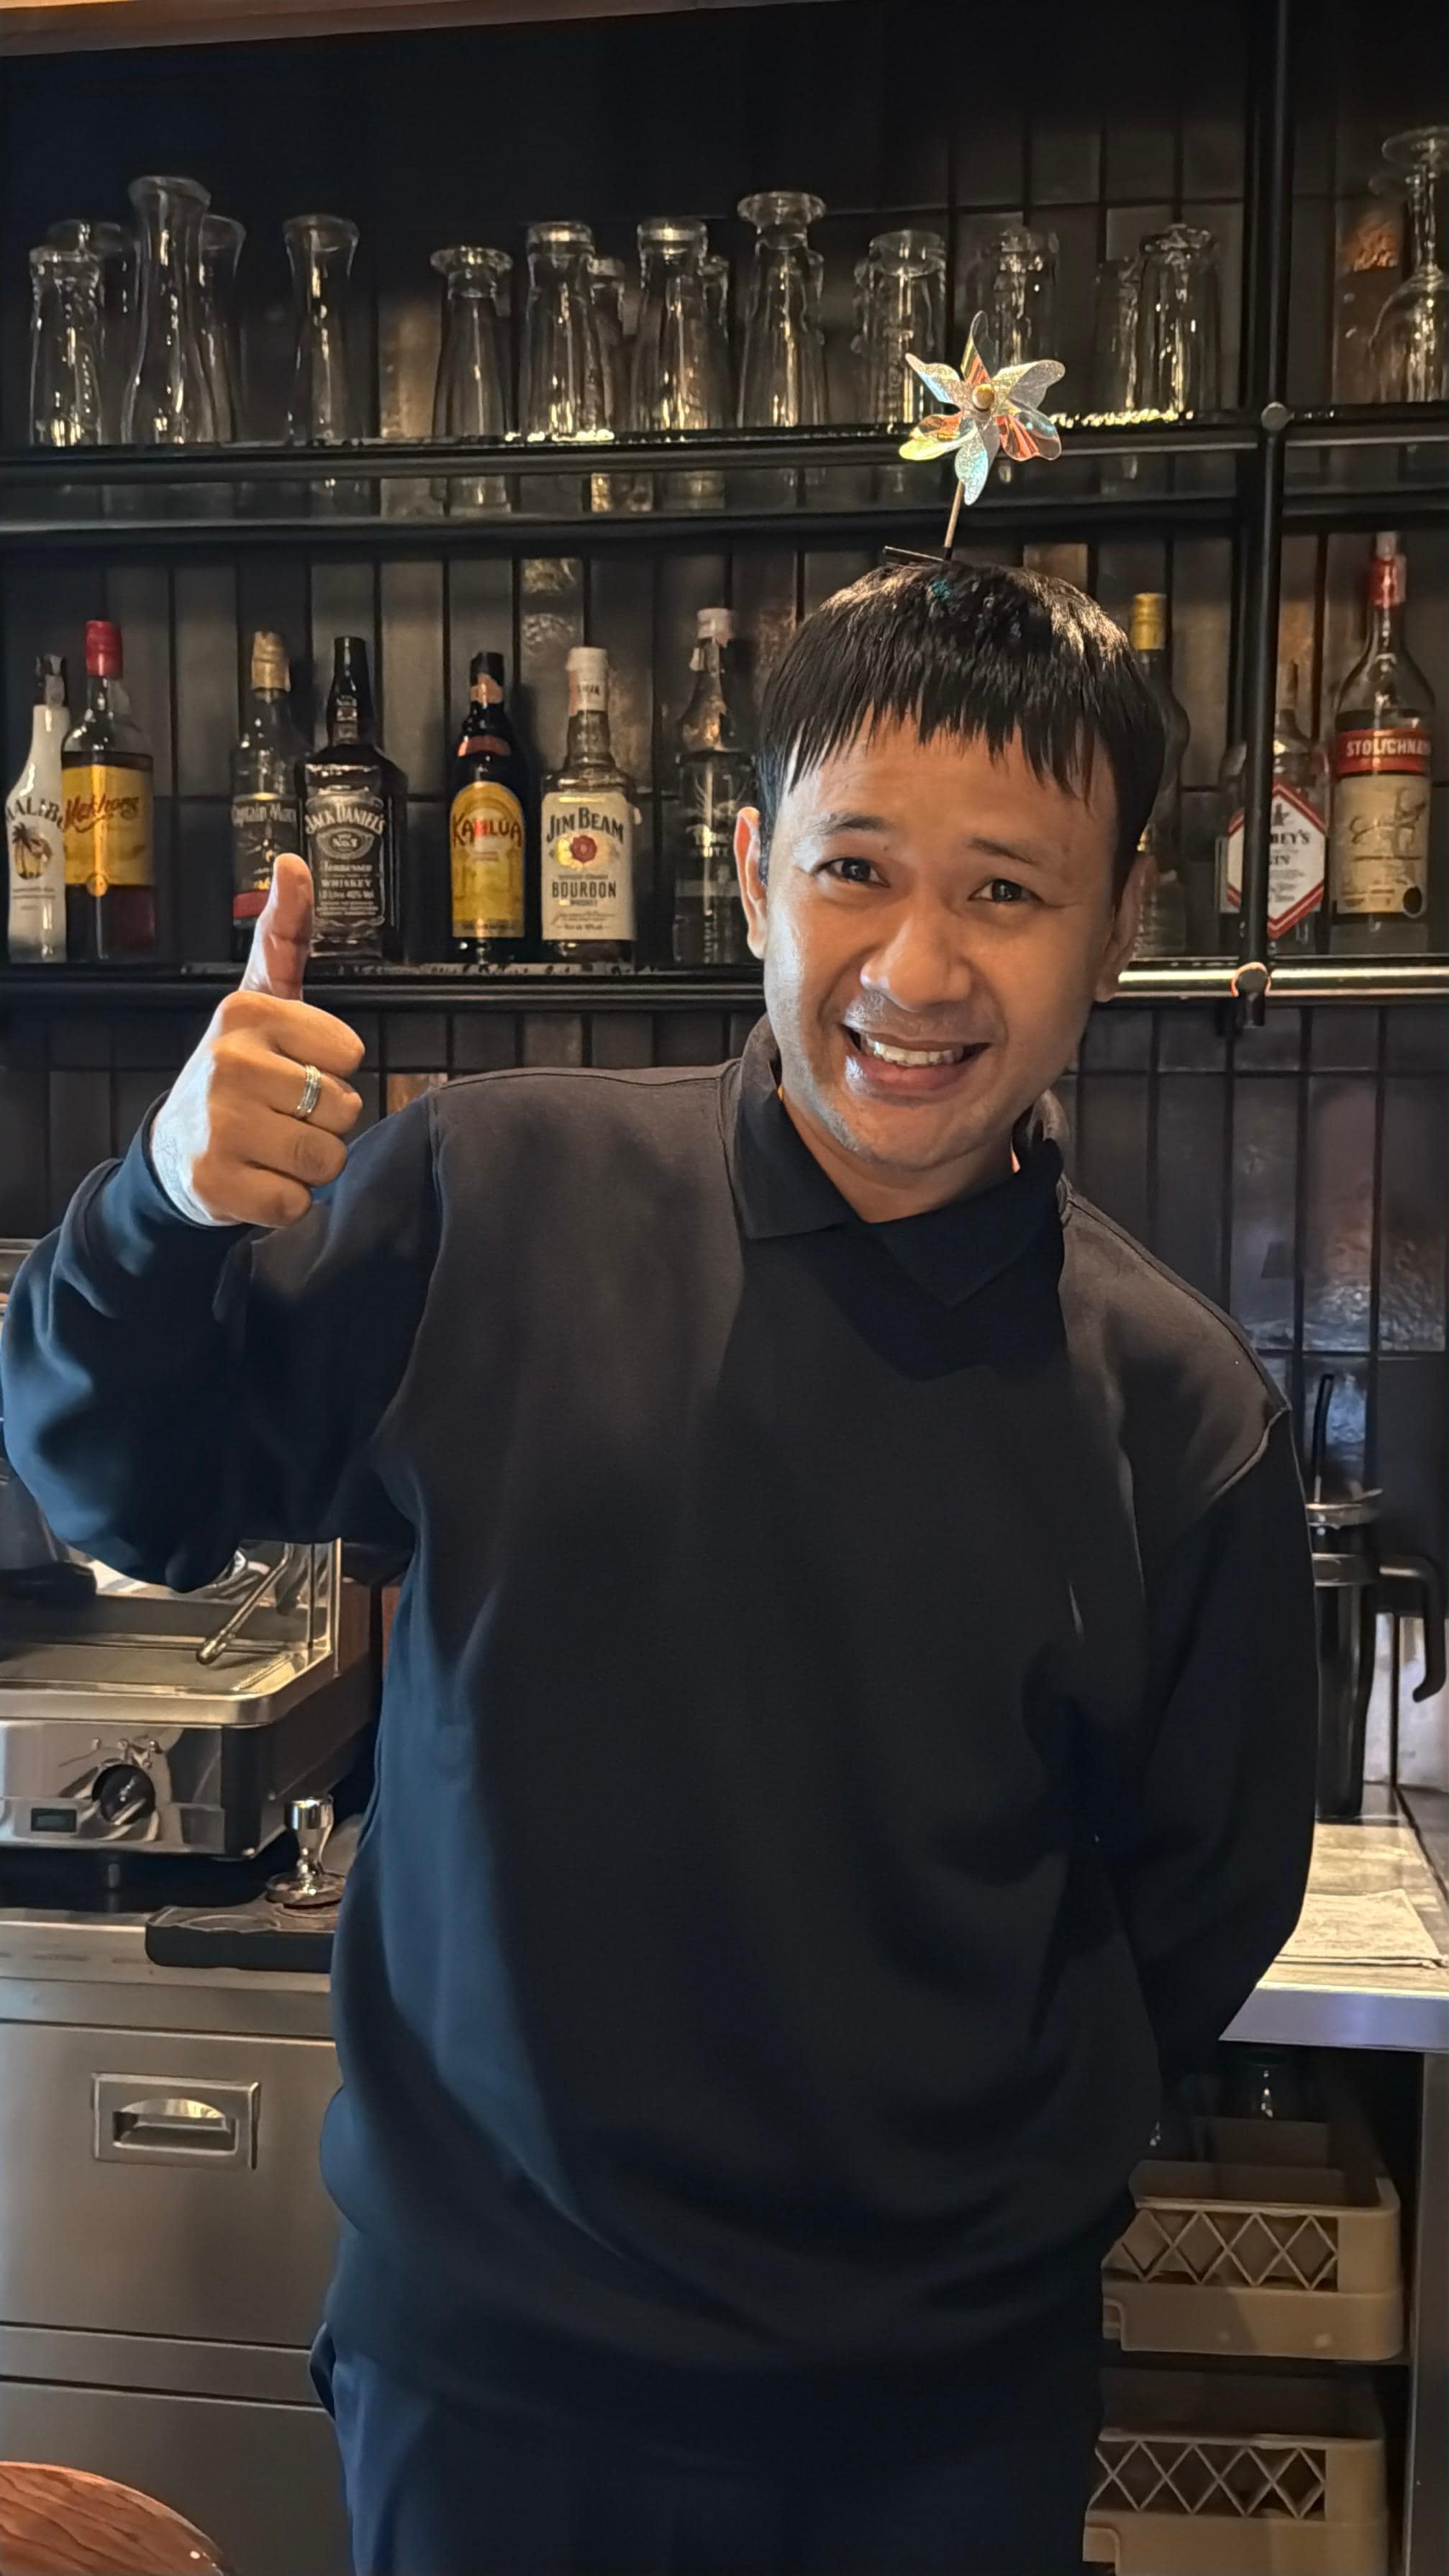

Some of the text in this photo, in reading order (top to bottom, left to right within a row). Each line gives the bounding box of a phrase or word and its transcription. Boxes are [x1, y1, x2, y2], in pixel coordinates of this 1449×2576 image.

[1347, 737, 1431, 756] STOLICHNA
[305, 802, 386, 835] JACK DANIEL'S
[546, 807, 624, 844] JIM BEAM
[1271, 830, 1311, 845] BEY'S
[551, 881, 617, 899] BOURBON
